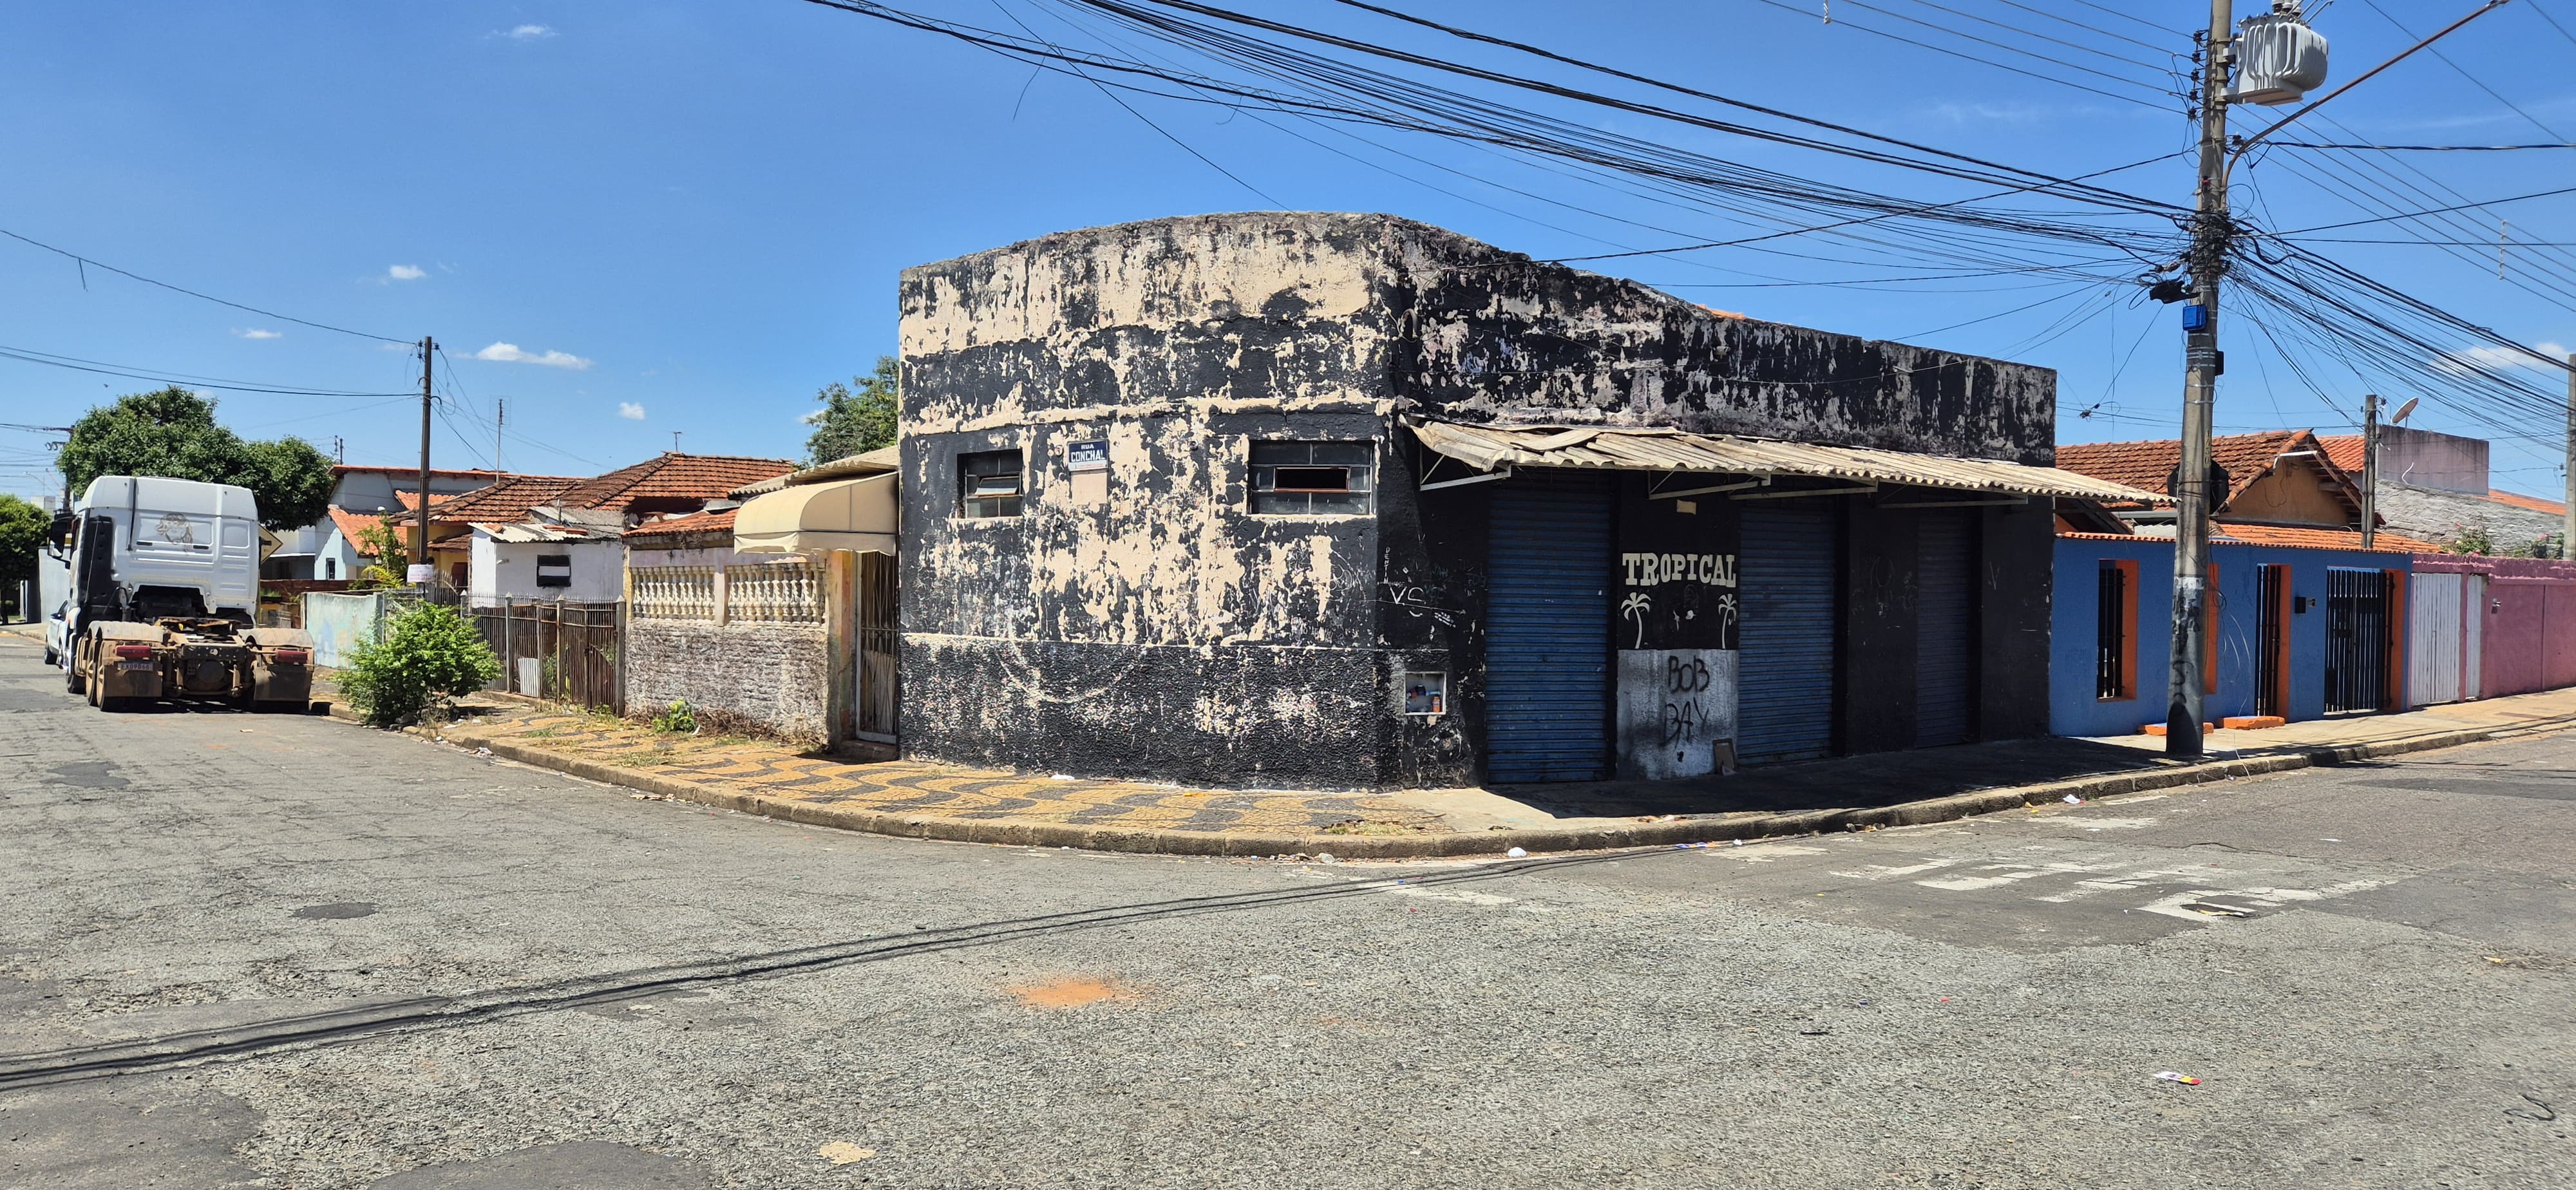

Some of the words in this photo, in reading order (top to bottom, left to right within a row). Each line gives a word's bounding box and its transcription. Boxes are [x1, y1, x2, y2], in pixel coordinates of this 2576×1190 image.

[1071, 449, 1105, 462] CONCHAL
[1622, 552, 1737, 588] TROPICAL
[1668, 654, 1710, 694] BOB
[1658, 696, 1709, 750] BAY
